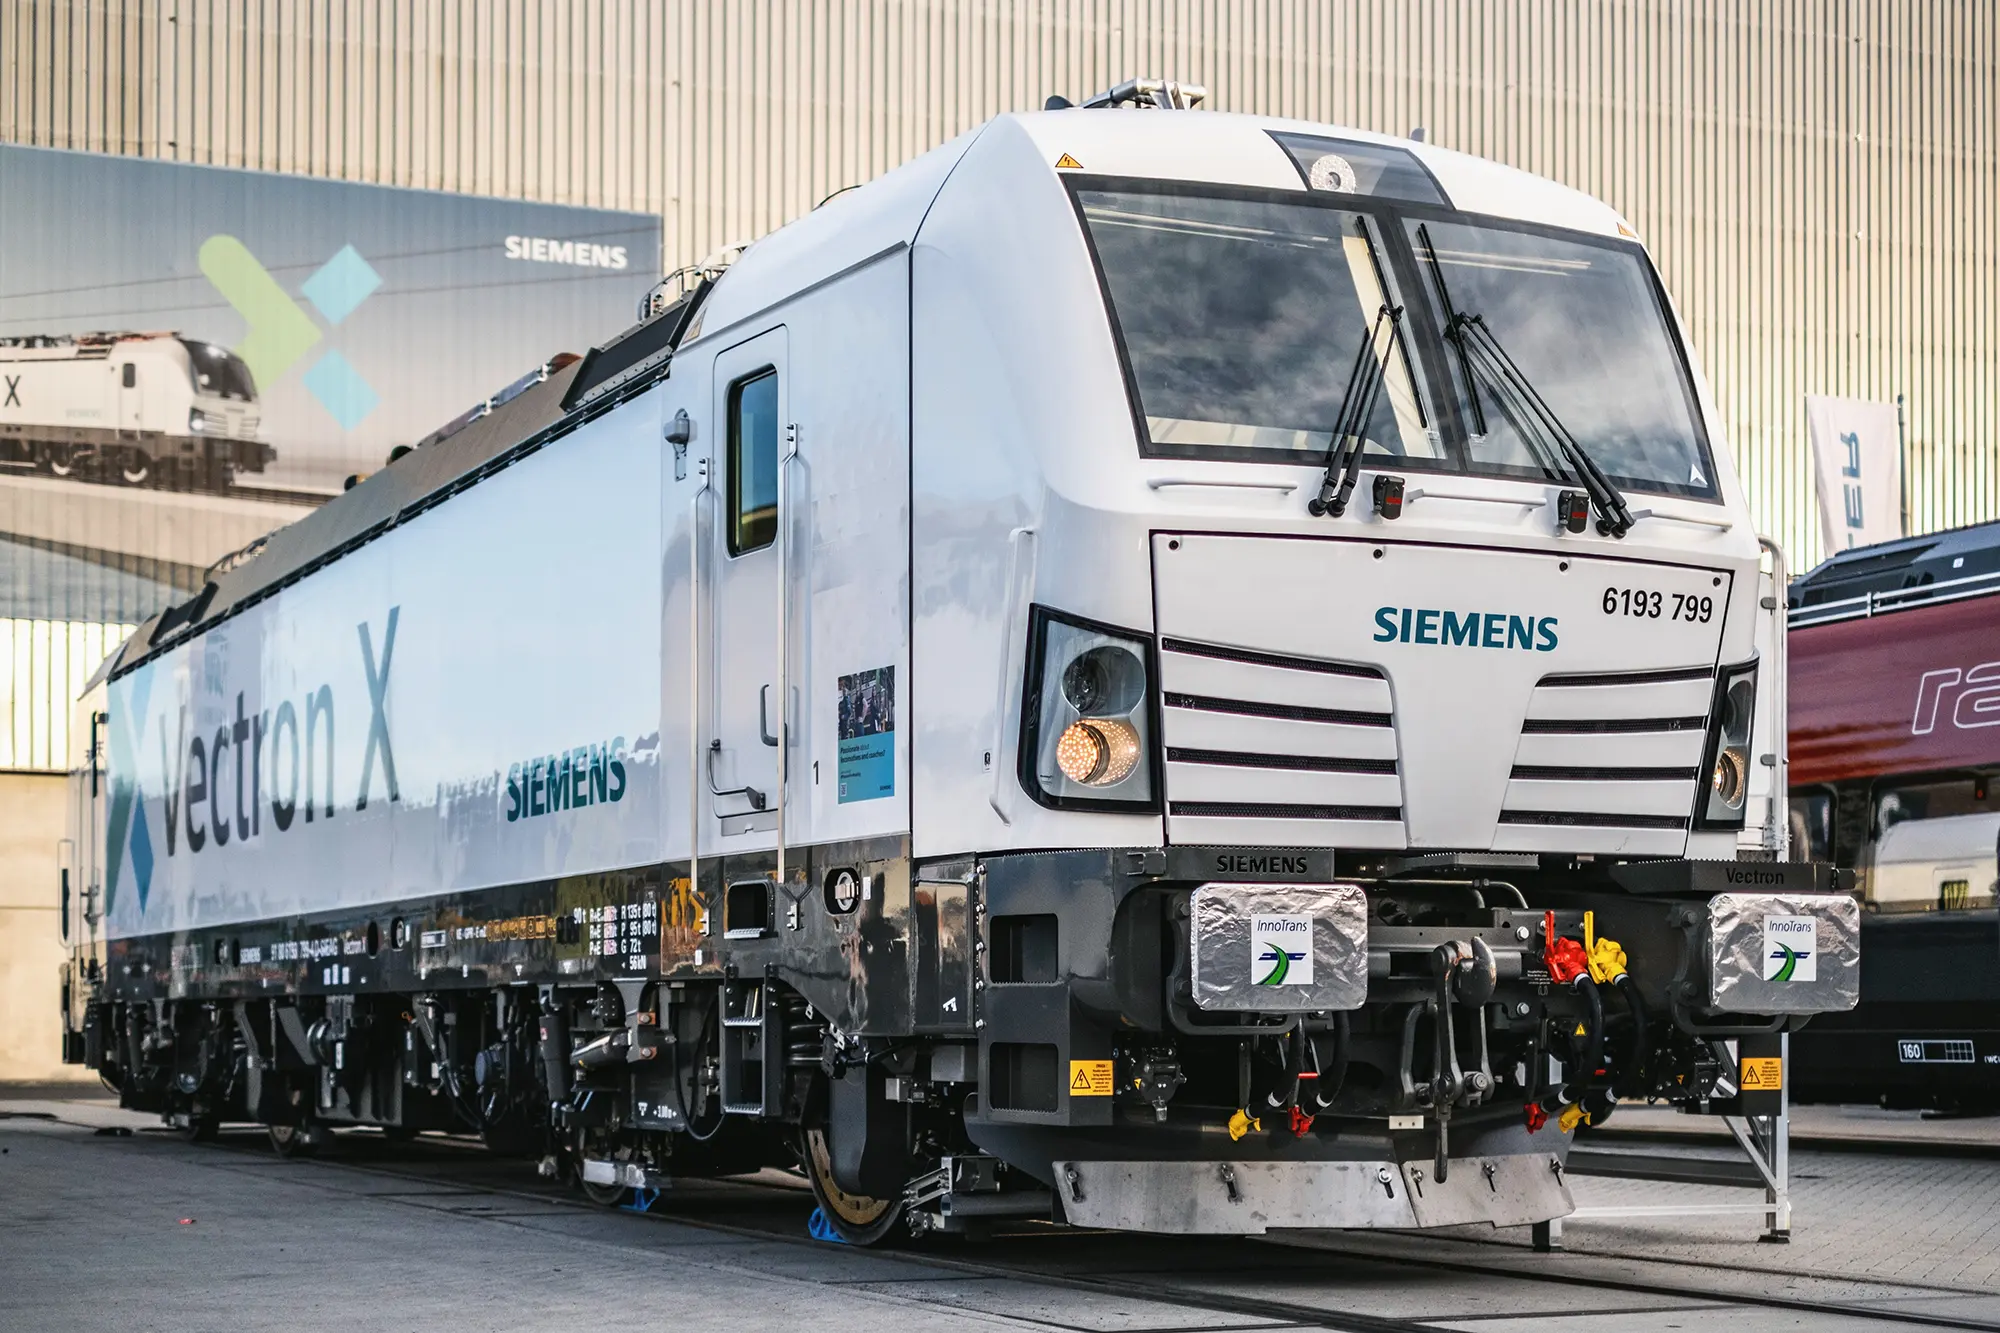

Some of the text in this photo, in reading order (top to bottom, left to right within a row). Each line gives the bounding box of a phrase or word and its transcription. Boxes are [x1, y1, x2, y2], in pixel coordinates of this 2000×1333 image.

[504, 234, 628, 270] SIEMENS
[4, 374, 22, 407] X
[1601, 586, 1714, 625] 6193 799
[1372, 606, 1559, 652] SIEMENS
[158, 604, 401, 857] Vectron X
[505, 735, 627, 823] SIEMENS
[812, 760, 819, 785] 1
[1216, 855, 1308, 874] SIEMENS
[1725, 867, 1785, 885] Vectron
[1257, 919, 1308, 932] InnoTrans
[1768, 920, 1812, 933] InnoTrans
[1902, 1043, 1921, 1059] 160
